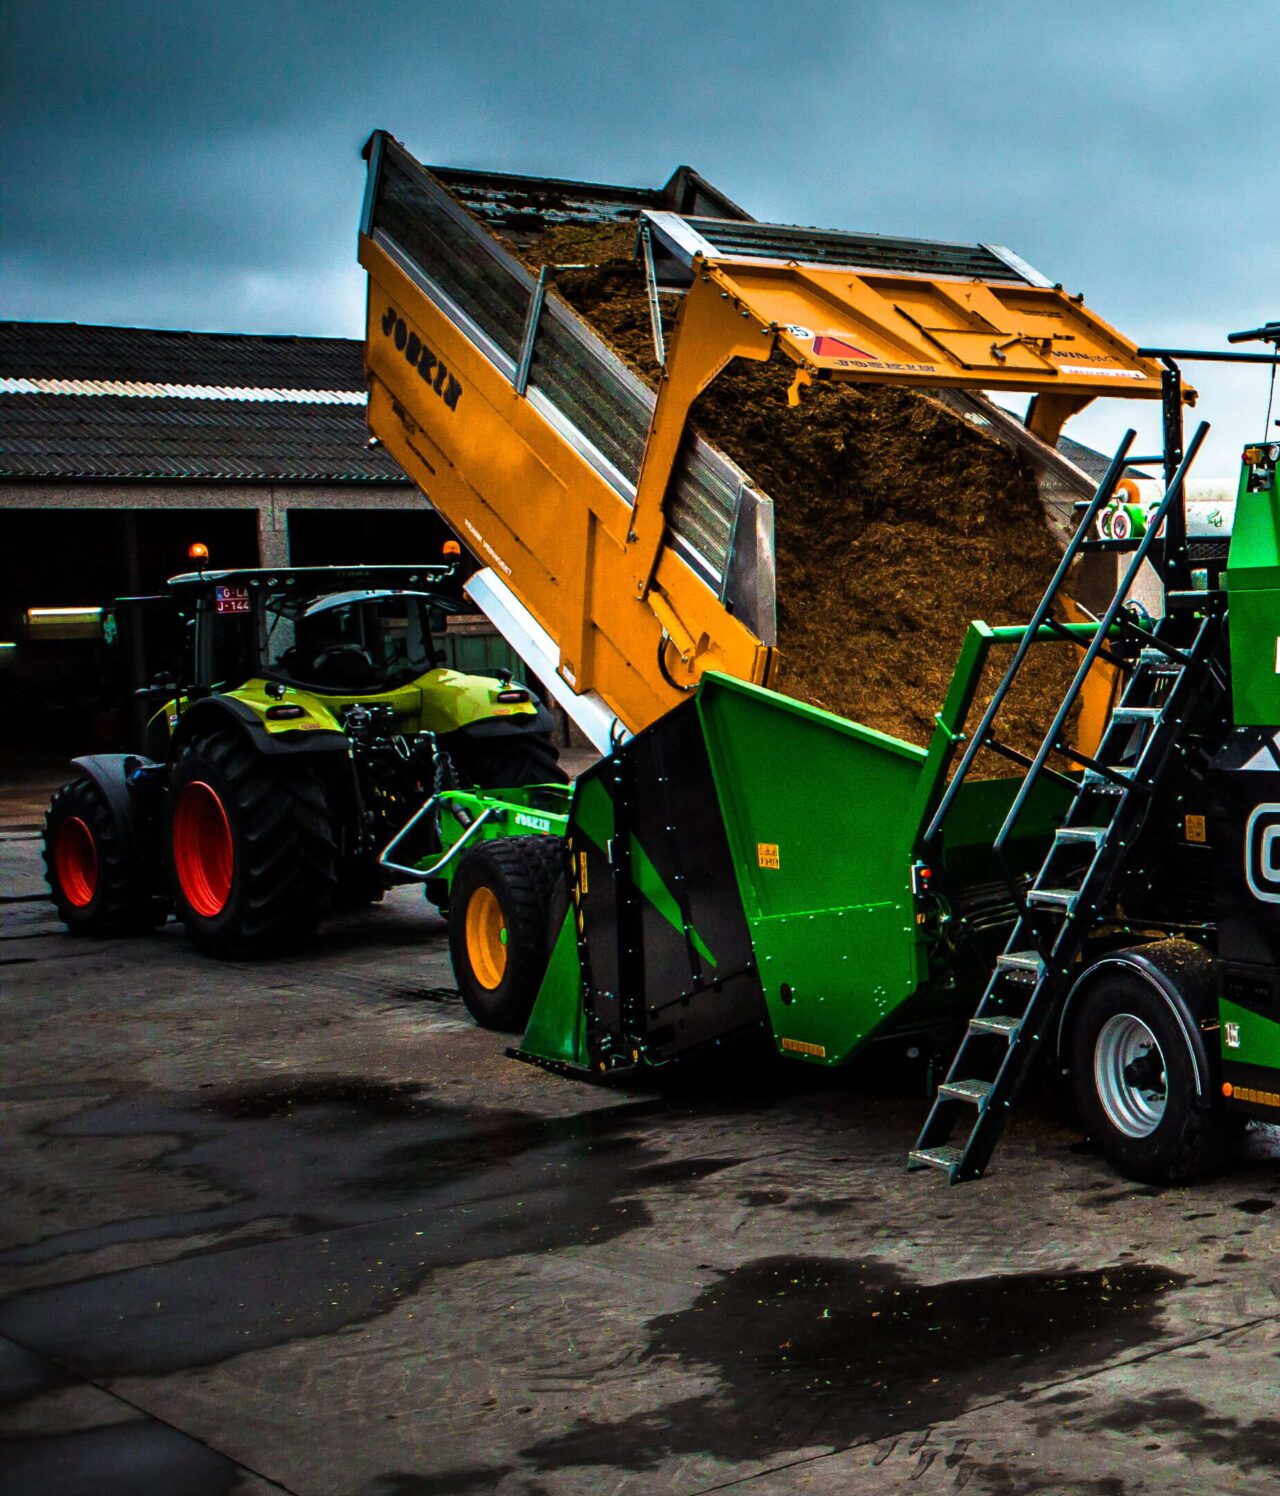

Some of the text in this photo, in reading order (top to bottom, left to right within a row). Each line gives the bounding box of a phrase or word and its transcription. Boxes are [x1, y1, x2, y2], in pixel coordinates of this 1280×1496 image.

[382, 306, 463, 412] JOSKIN
[834, 359, 936, 372] JOSKIN
[217, 601, 249, 611] J-144
